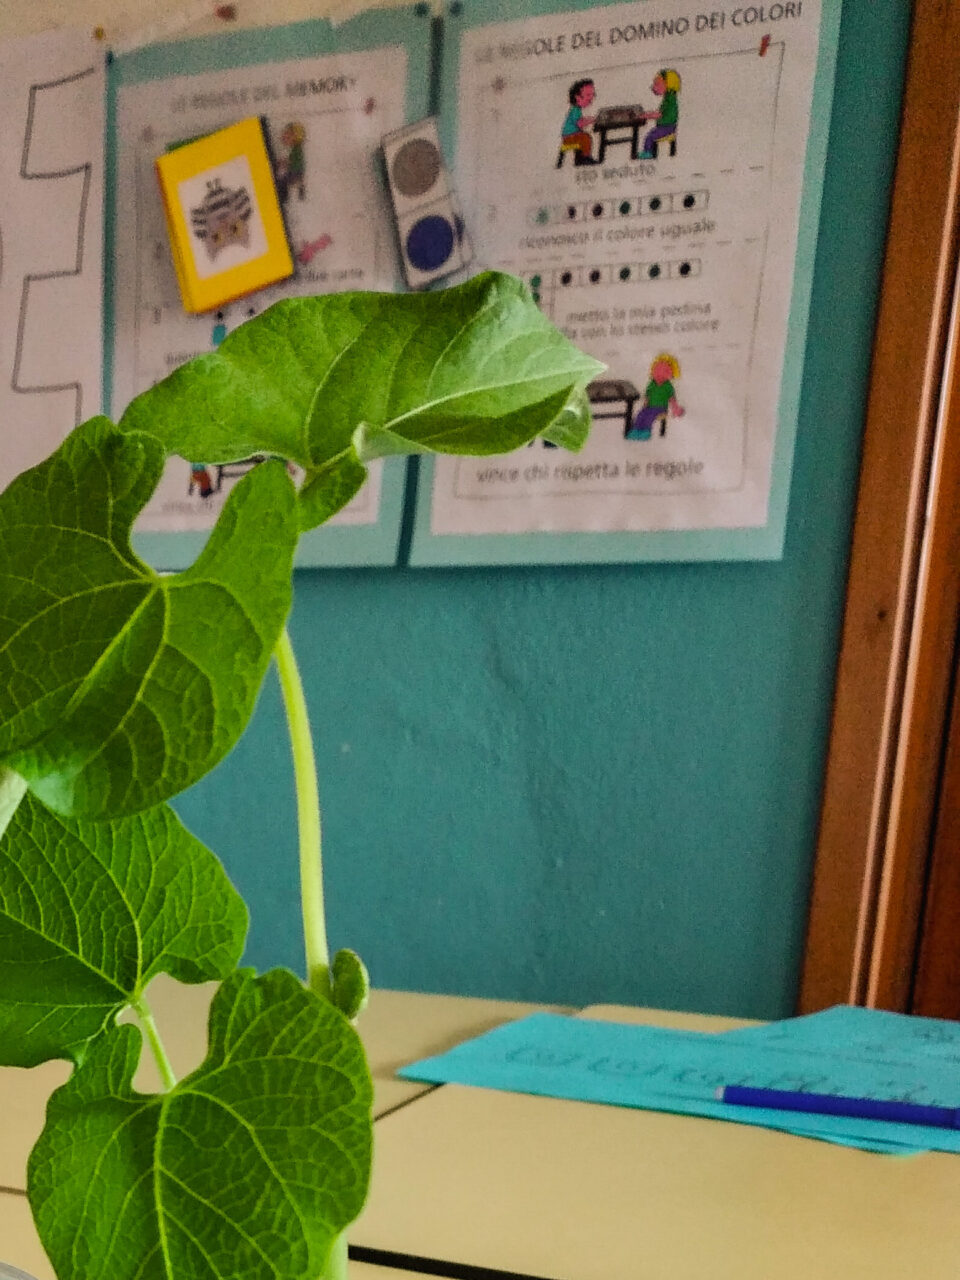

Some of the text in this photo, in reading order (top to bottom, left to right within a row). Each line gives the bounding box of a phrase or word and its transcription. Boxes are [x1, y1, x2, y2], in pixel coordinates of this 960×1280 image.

[571, 31, 601, 49] DEL
[609, 17, 689, 46] DOMINO
[695, 12, 726, 32] DEI
[731, 1, 803, 29] COLORI
